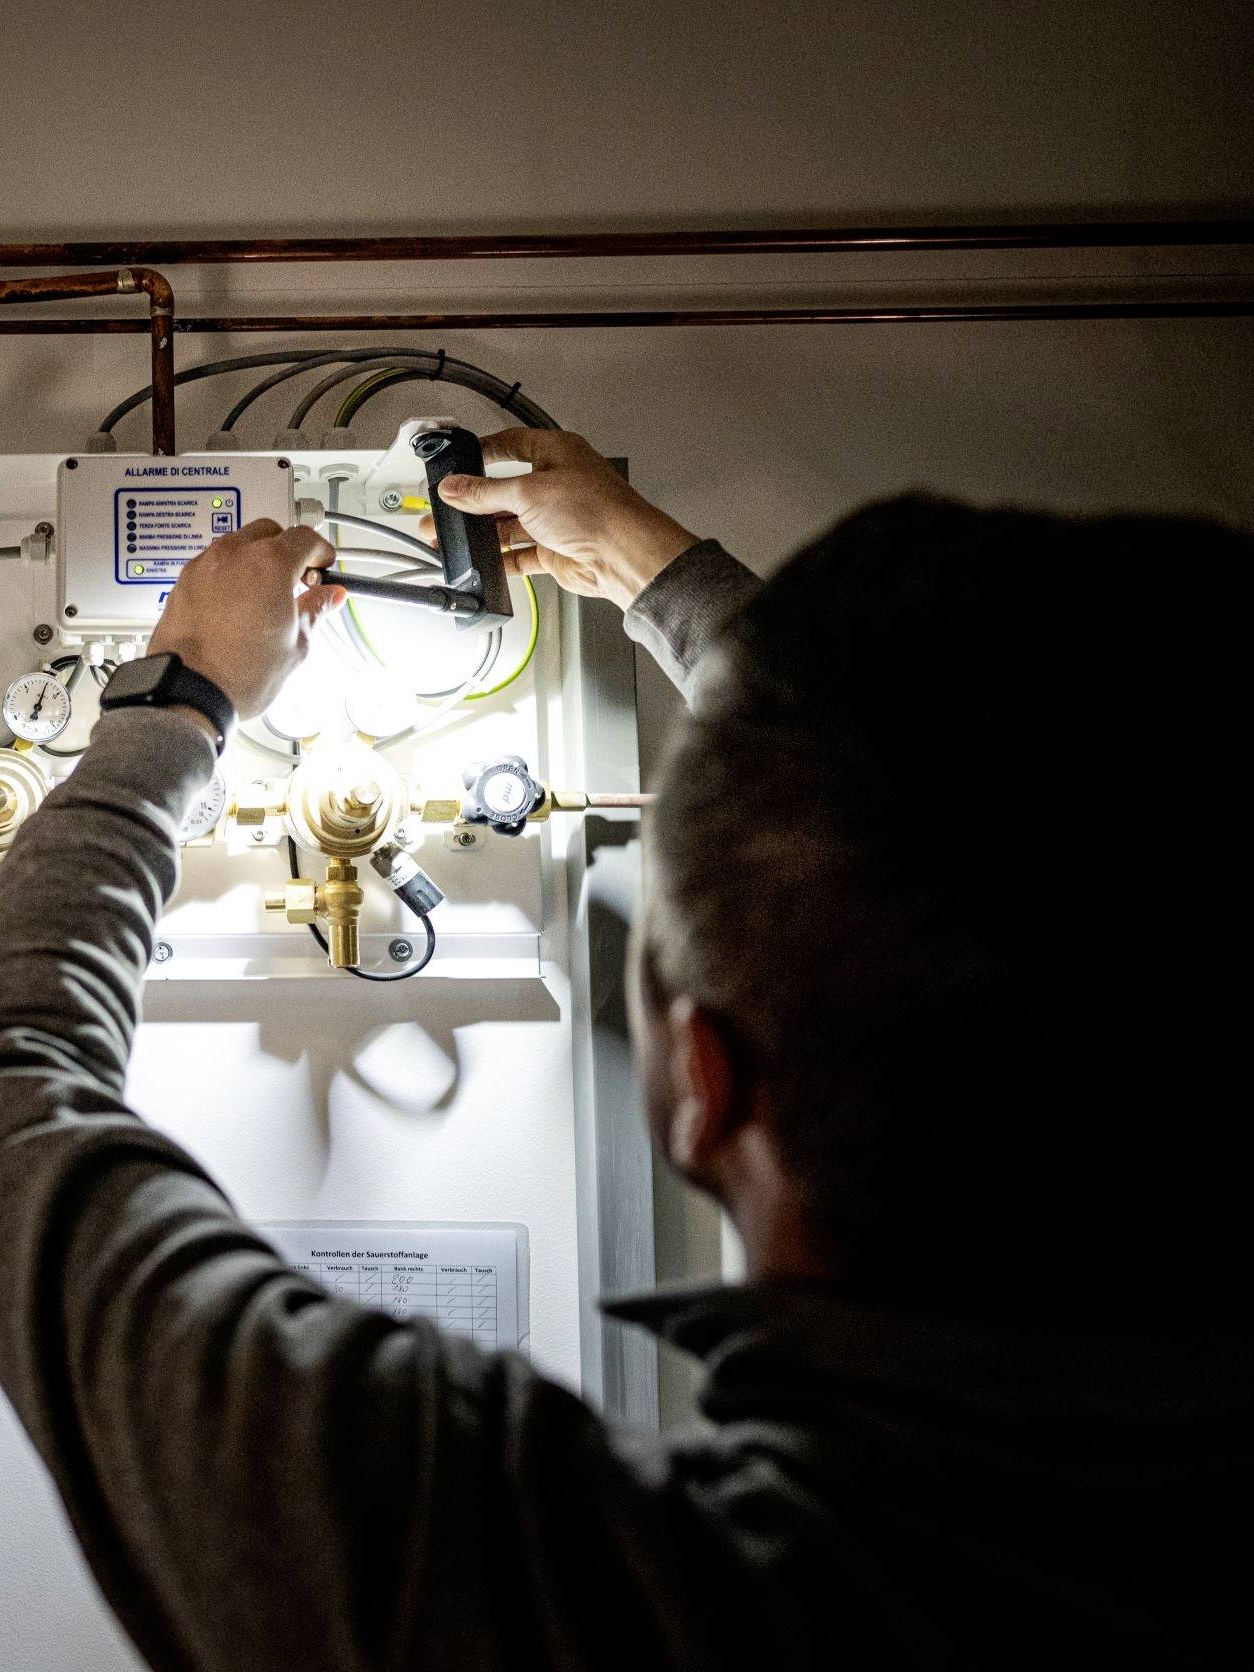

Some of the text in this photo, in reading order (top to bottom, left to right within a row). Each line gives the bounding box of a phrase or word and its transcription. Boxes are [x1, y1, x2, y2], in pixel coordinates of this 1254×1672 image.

[125, 466, 230, 477] ALLARME DI CENTRALE
[497, 764, 520, 774] OPEN
[490, 811, 517, 821] CLOSE
[311, 1250, 350, 1258] Kontrollen
[366, 1251, 429, 1260] Sauerstoffanlage
